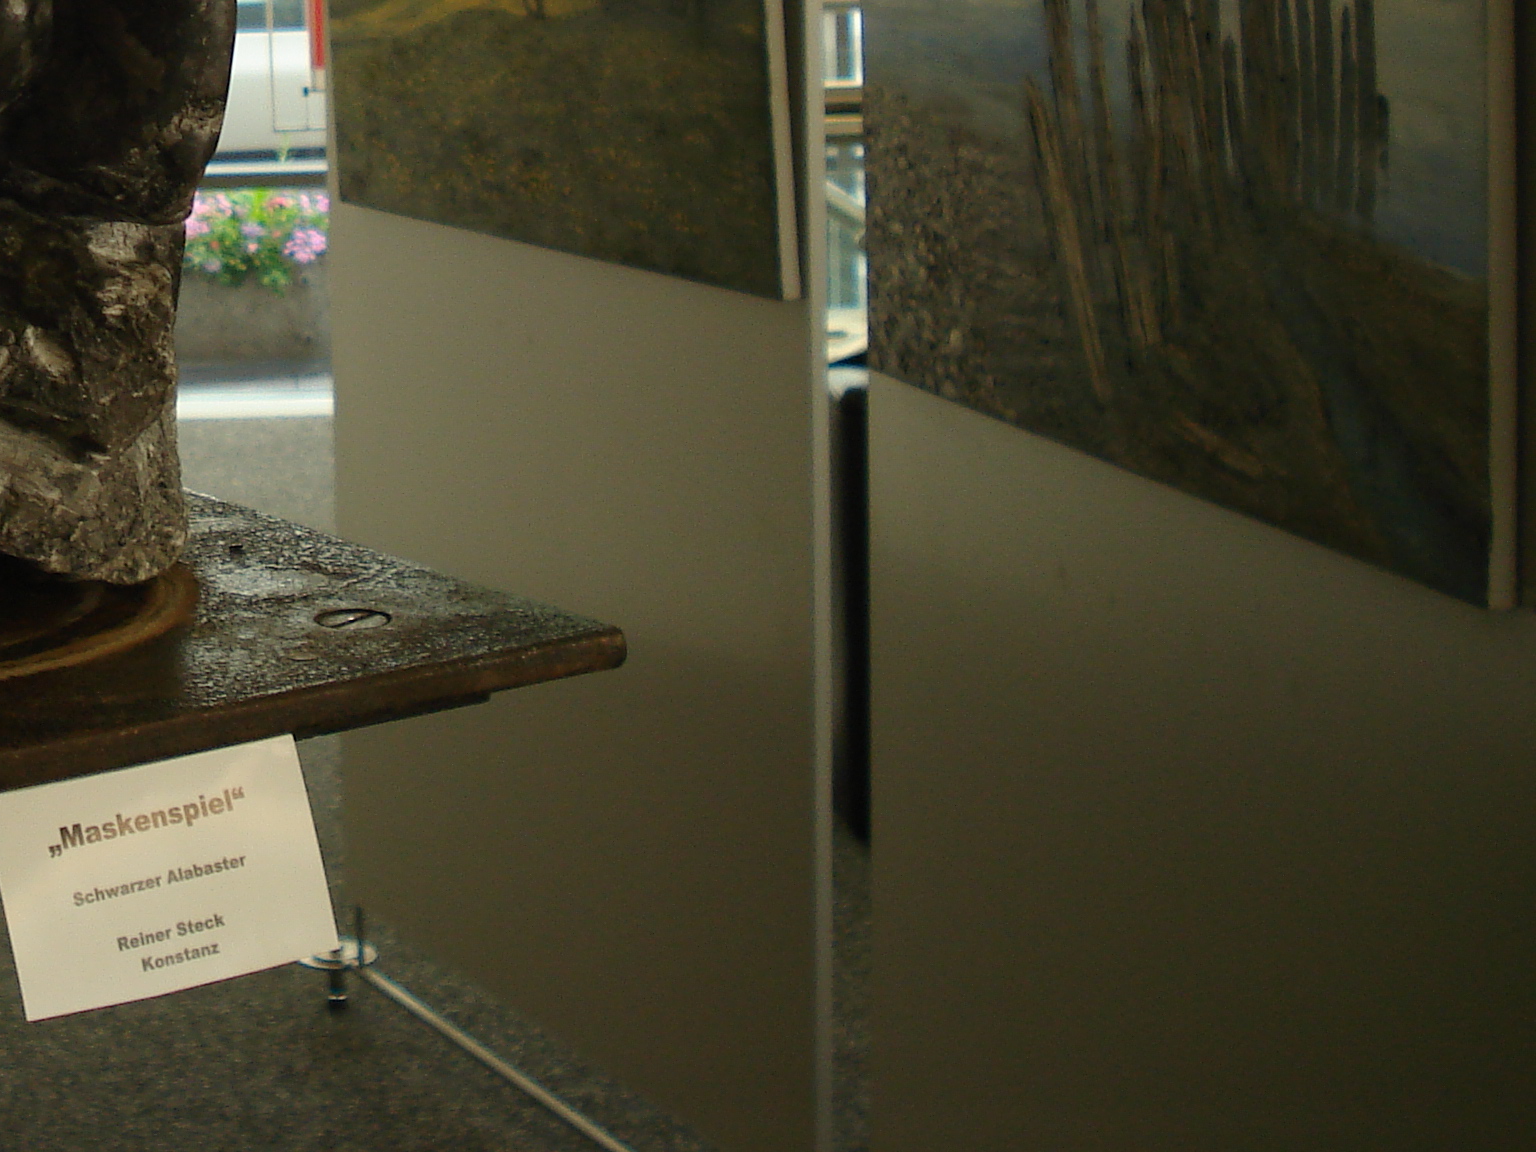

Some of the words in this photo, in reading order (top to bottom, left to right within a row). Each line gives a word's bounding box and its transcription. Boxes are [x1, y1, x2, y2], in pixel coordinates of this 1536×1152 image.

[73, 874, 162, 907] Schwarzer
[167, 854, 247, 885] Alabaster
[116, 927, 172, 952] Reiner
[176, 913, 226, 937] Steck
[141, 942, 221, 973] Konstanz
